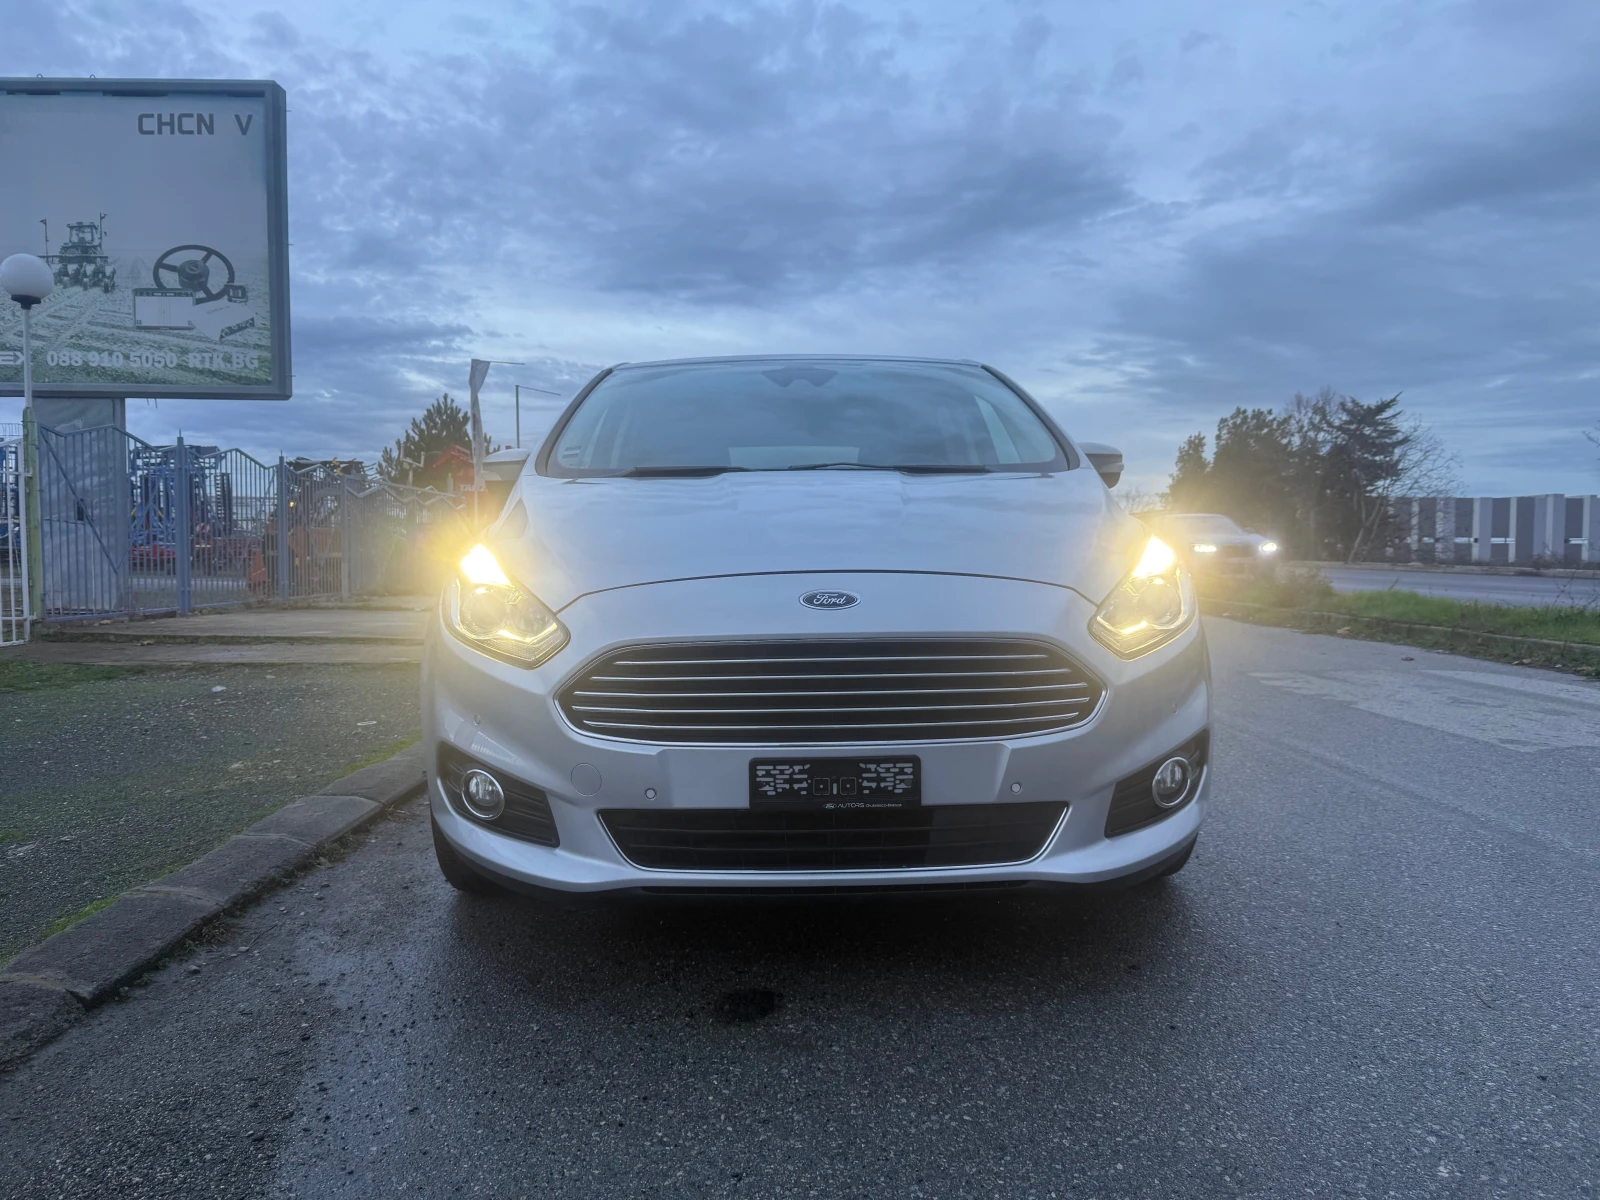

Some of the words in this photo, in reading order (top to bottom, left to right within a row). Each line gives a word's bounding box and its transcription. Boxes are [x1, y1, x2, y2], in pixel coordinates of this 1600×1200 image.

[138, 113, 214, 135] CHCN
[46, 351, 83, 366] 088
[87, 351, 123, 366] 910
[129, 351, 177, 368] 5050
[188, 351, 259, 369] RTK.BG
[813, 593, 847, 605] Ford
